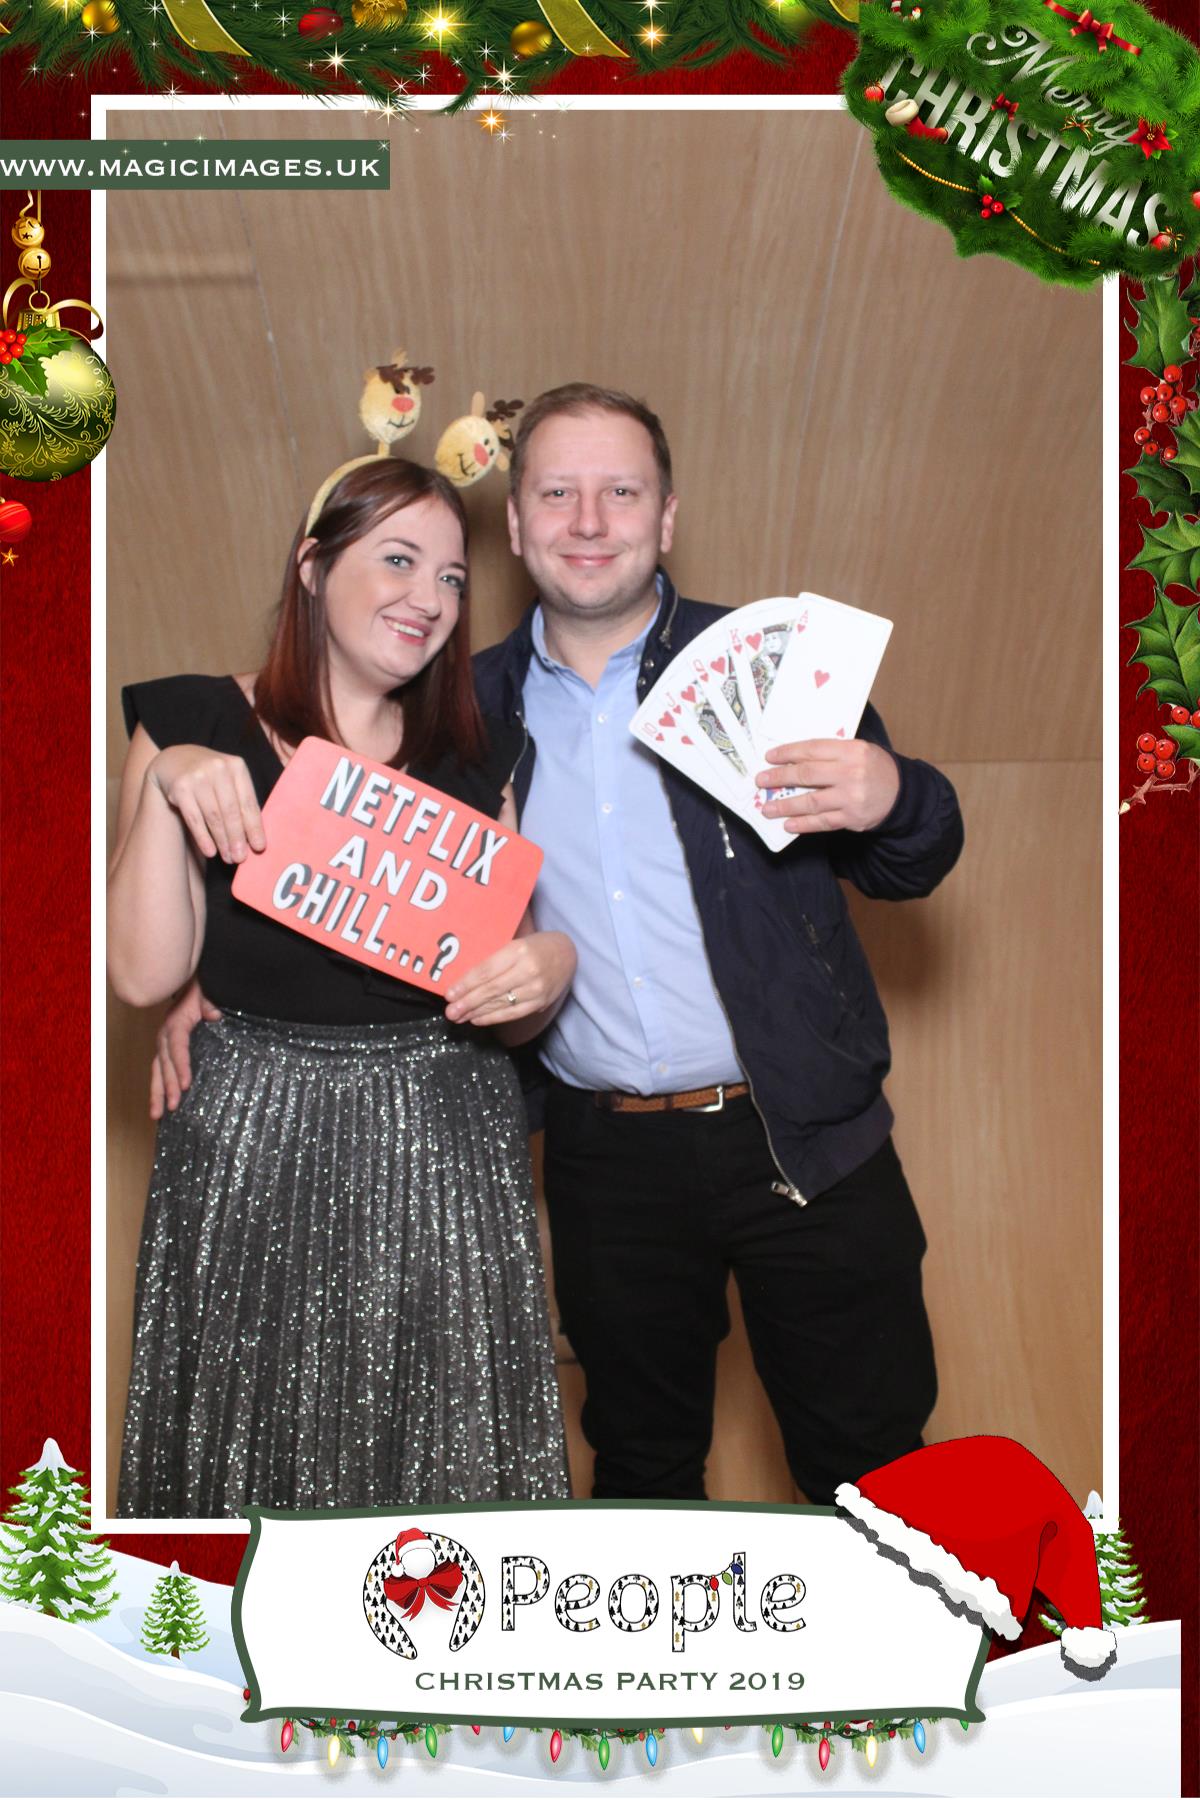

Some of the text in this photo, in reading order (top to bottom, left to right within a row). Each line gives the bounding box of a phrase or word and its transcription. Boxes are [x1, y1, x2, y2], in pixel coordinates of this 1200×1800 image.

[319, 756, 508, 886] NETFLIX
[328, 834, 448, 911] AND
[271, 862, 461, 983] CHILL...?
